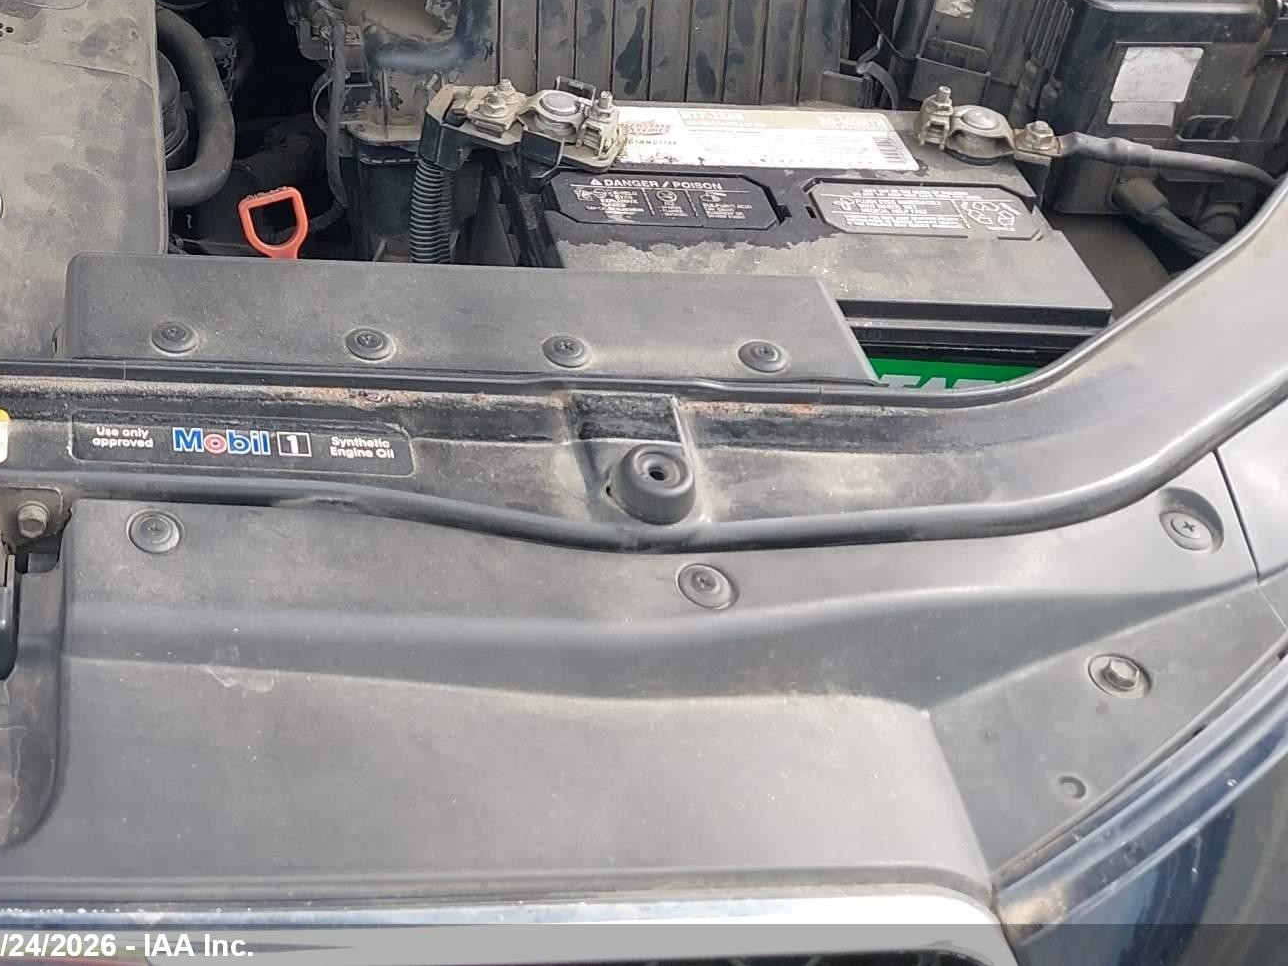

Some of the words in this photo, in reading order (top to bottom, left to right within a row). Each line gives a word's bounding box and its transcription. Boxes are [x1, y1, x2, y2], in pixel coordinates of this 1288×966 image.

[673, 181, 722, 190] POISON
[96, 426, 119, 436] Use
[123, 427, 149, 438] only
[93, 436, 154, 449] approved
[172, 427, 271, 457] Mobil
[331, 436, 390, 449] Synthetic
[330, 446, 373, 459] Engine
[377, 448, 394, 459] Oil
